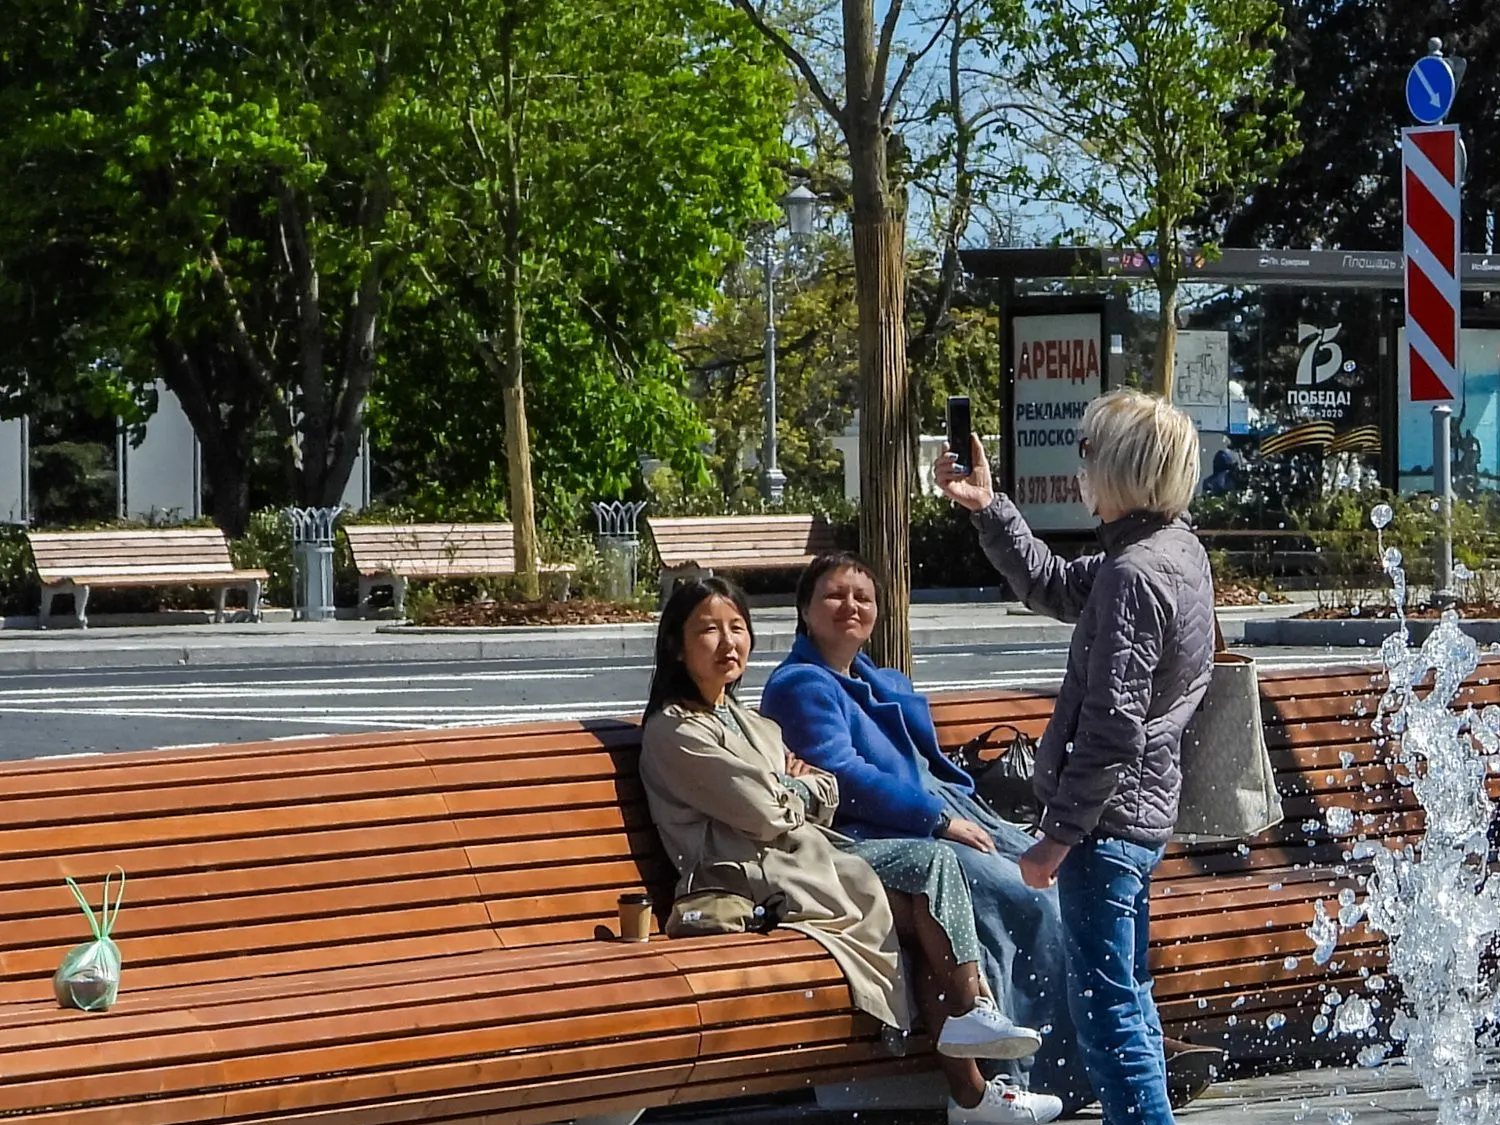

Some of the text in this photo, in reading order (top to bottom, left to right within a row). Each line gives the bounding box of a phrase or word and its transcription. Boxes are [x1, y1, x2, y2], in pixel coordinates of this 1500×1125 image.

[1342, 255, 1397, 270] Площадь
[1017, 339, 1099, 384] АРЕНДА
[1295, 321, 1343, 385] 75
[1287, 390, 1351, 408] ПОБЕДА!
[1017, 428, 1084, 448] ПЛОСКО
